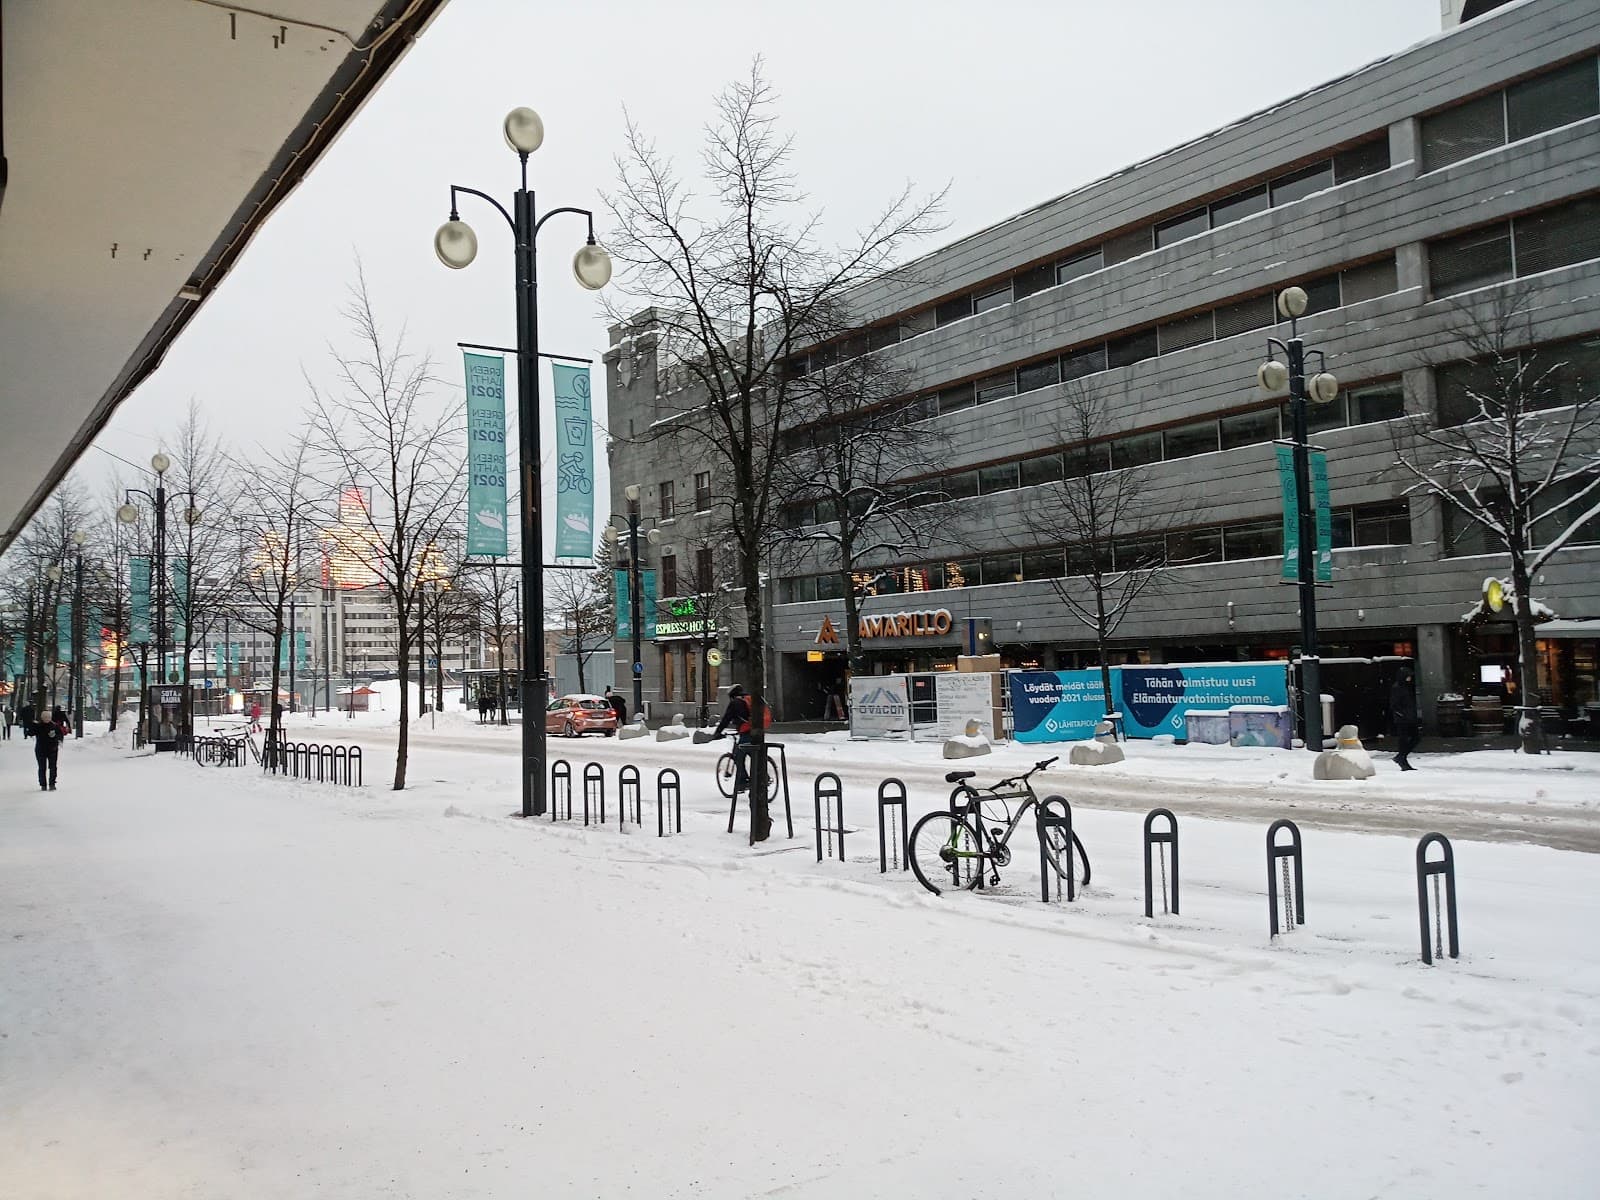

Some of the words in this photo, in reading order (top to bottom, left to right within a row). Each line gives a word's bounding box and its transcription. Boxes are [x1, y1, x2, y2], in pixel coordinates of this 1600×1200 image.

[655, 621, 689, 635] ESPRESSO
[859, 609, 951, 639] AMARILLO
[1023, 682, 1054, 693] Löydät
[1055, 682, 1085, 692] meidät
[1144, 677, 1174, 688] Tähän
[1176, 677, 1229, 688] valmistuu
[1232, 676, 1256, 687] uusi
[1029, 694, 1061, 704] vuoden
[1062, 693, 1081, 702] 2021
[1059, 719, 1098, 729] LÄHITAPIOLA
